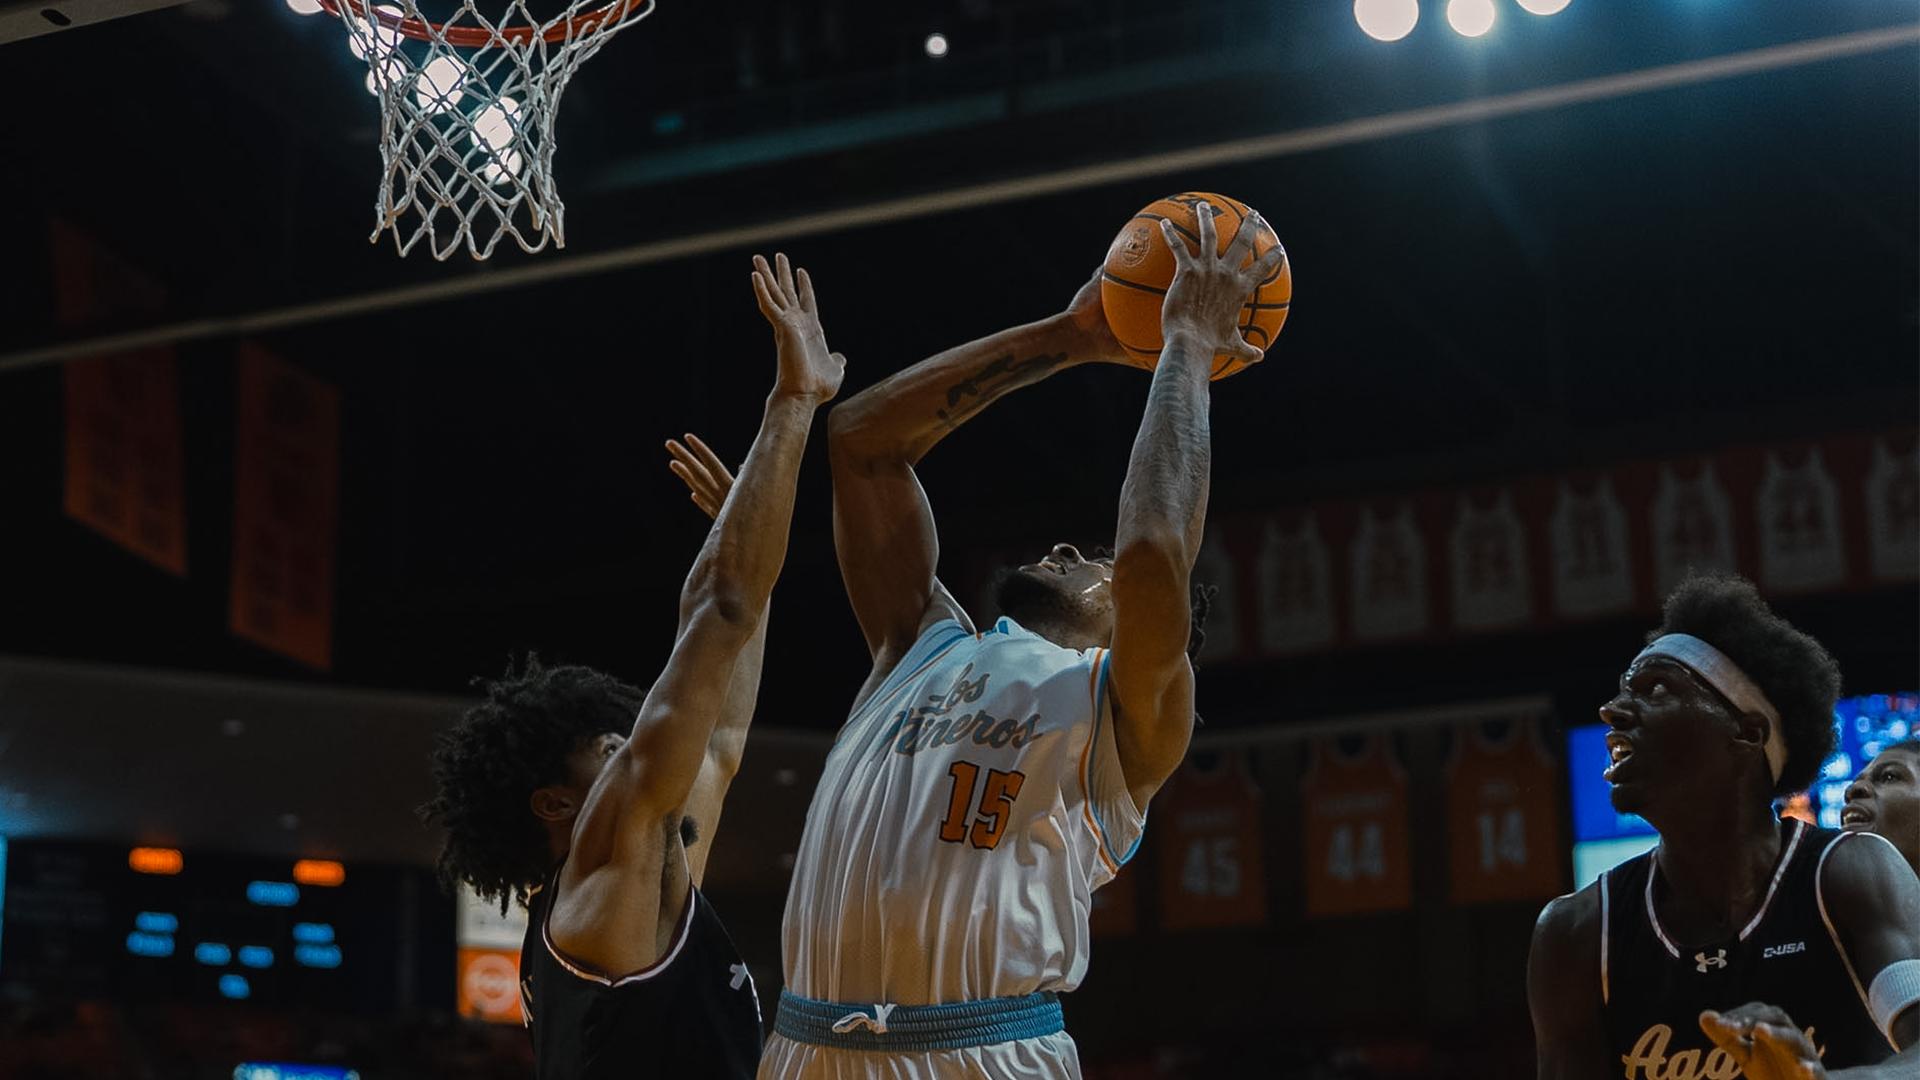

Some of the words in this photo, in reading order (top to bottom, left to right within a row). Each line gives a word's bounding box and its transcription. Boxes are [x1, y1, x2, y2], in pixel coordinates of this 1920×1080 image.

[918, 662, 990, 716] Los
[938, 760, 1026, 851] 15
[1182, 836, 1241, 897] 45
[1327, 823, 1385, 882] 44
[1478, 809, 1527, 870] 14
